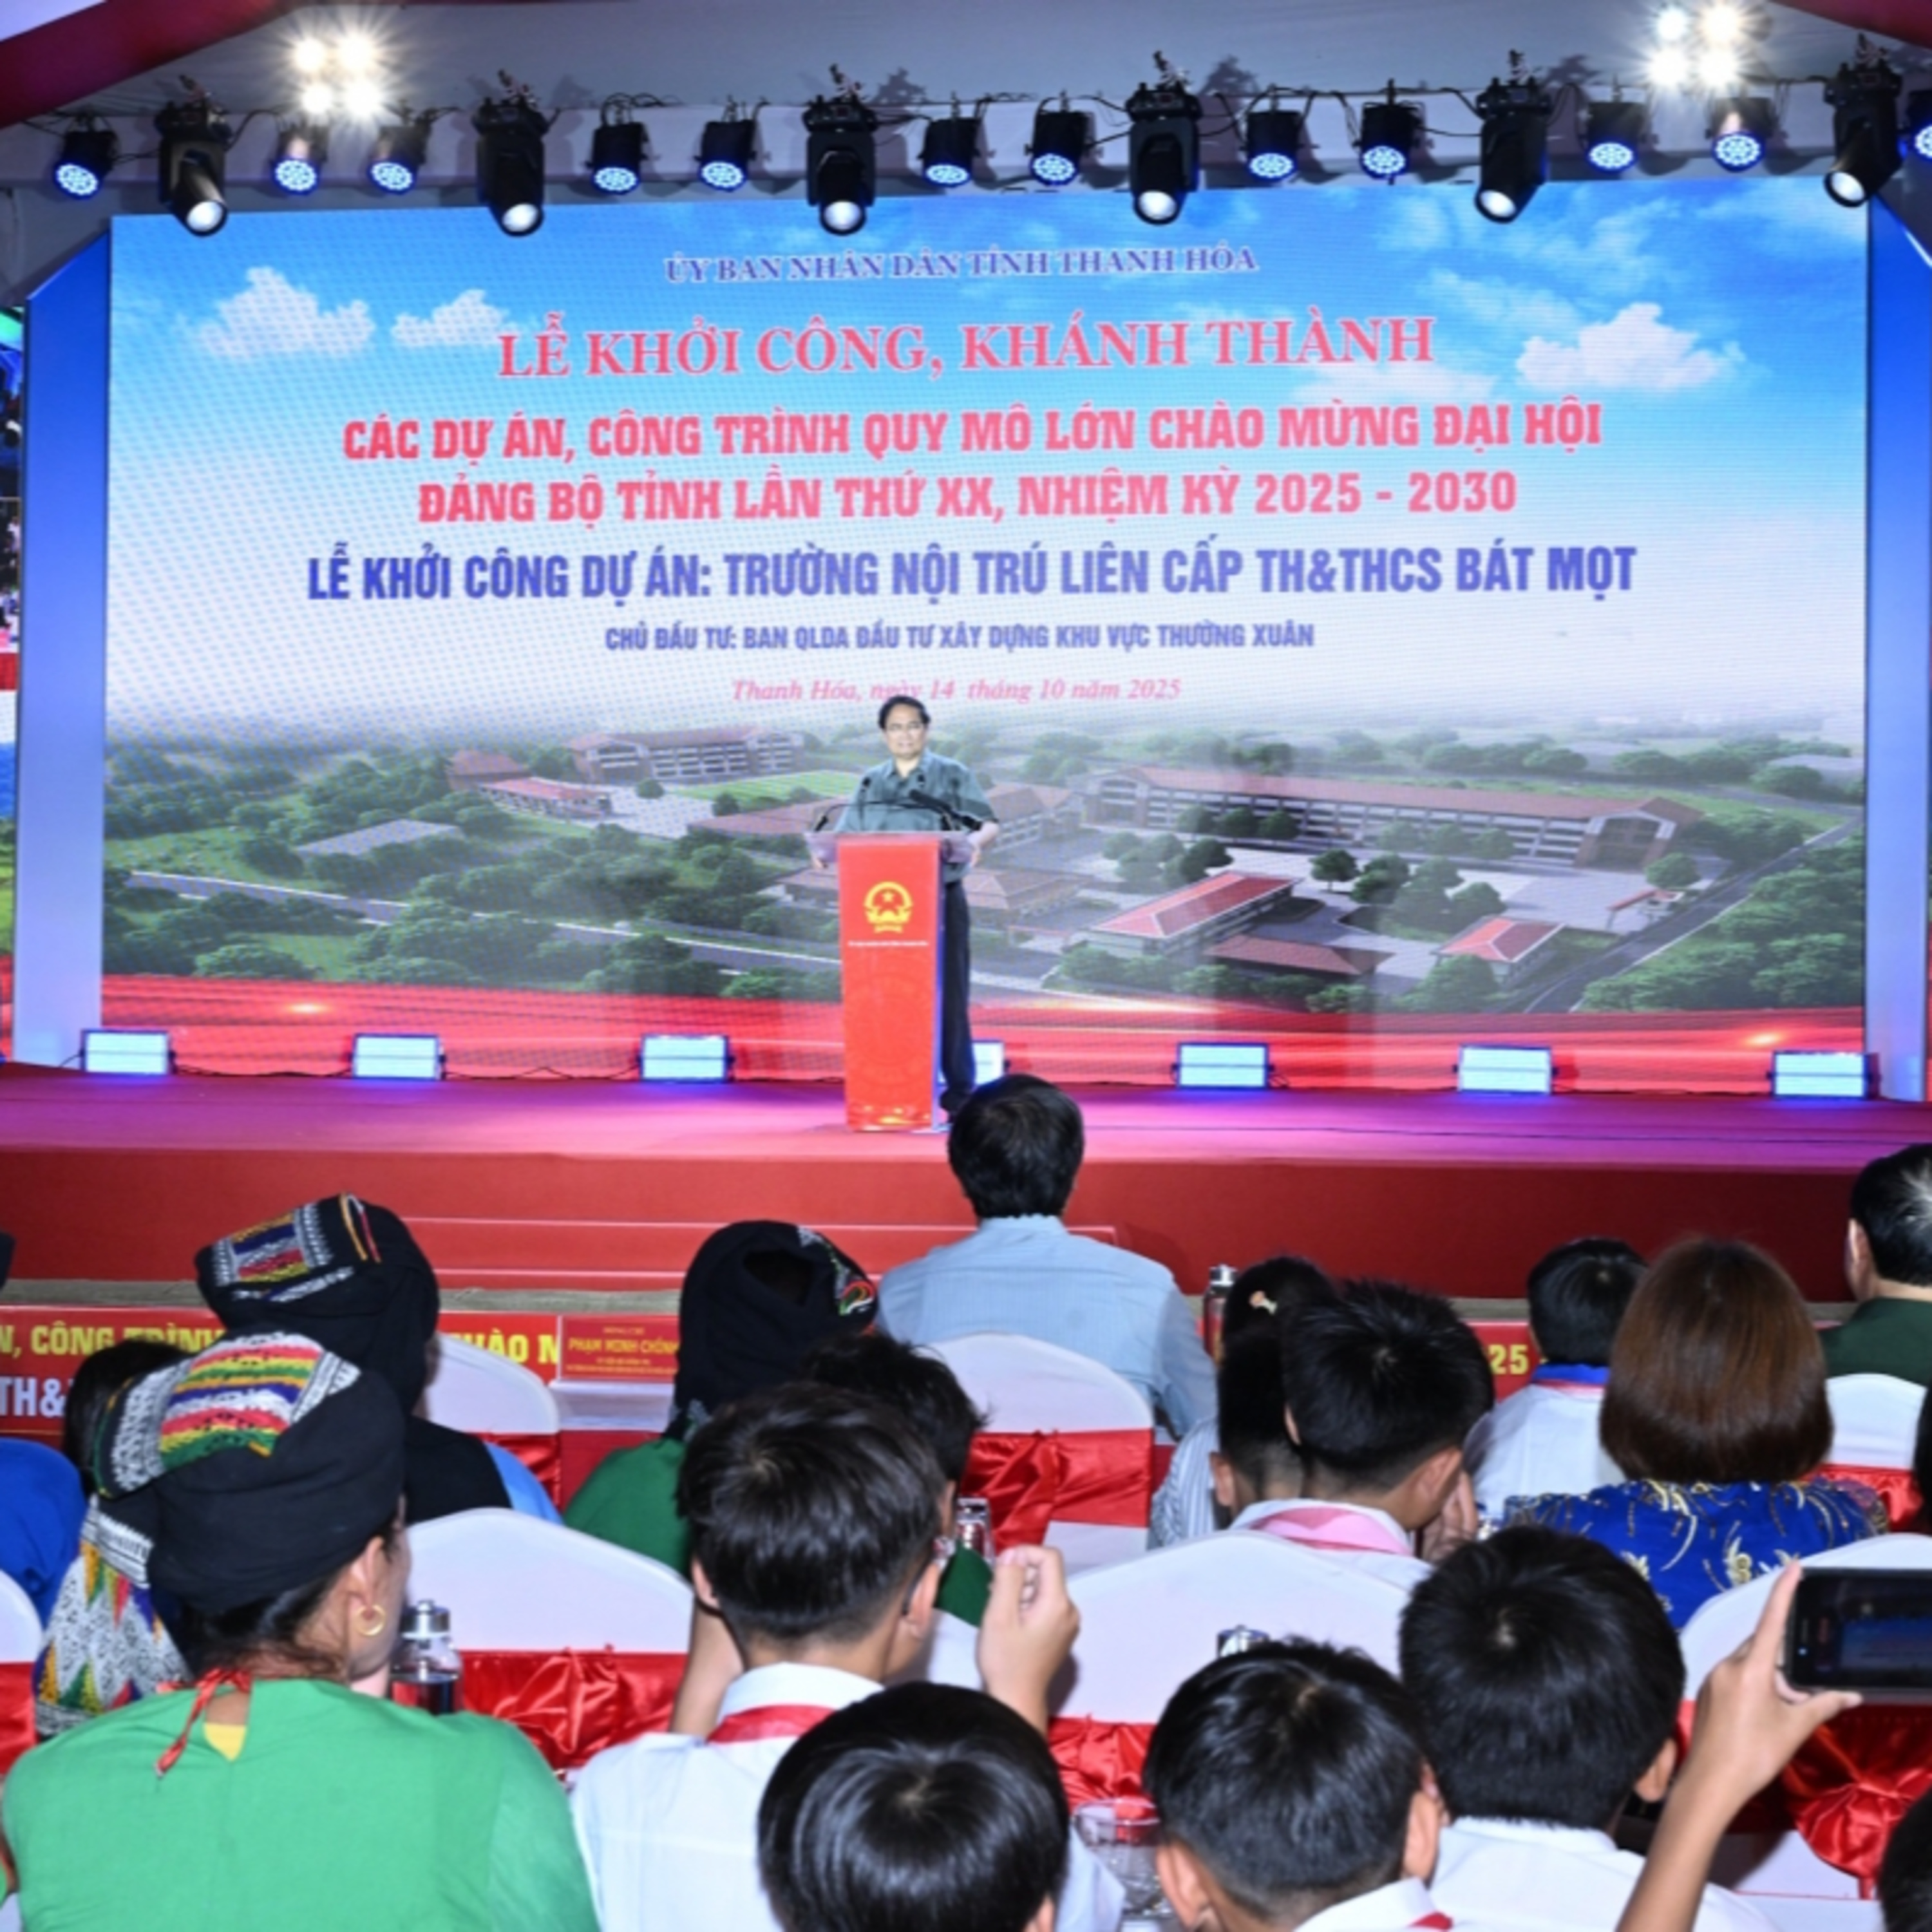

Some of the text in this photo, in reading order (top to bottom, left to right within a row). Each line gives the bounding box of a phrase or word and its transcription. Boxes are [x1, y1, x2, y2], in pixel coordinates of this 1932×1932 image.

[717, 258, 781, 281] BAN
[790, 250, 883, 279] NHÂN
[891, 248, 960, 278] DÂN
[1059, 250, 1175, 274] THANH
[1184, 242, 1258, 272] HÓA
[498, 306, 1434, 380] LỄ KHỞI CÔNG, KHÁNH THÀNH
[343, 394, 1602, 467] CÁC DỰ ÁN, CÔNG TRÌNH QUY MÔ LỚN CHÀO MỪNG ĐẠI HỘI
[418, 463, 1517, 530] ĐẢNG BỘ TỈNH LẦN THỨ XX, NHIỆM KỲ 2025 - 2030
[307, 533, 1638, 607] LỄ KHỞI CÔNG DỰ ÁN: TRƯỜNG NỘI TRÚ LIÊN CẤP TH&THCS BÁT MỌT
[605, 620, 649, 651] CHỦ
[743, 626, 788, 649] BAN
[794, 625, 849, 651] QLDA
[906, 623, 935, 649] TƯ
[940, 620, 983, 649] XÂY
[989, 623, 1049, 653] DỰNG
[1056, 624, 1101, 649] KHU
[1106, 622, 1151, 653] VỰC
[1157, 618, 1245, 648] THƯỜNG
[1252, 619, 1314, 647] XUÂN
[732, 678, 802, 701] Thanh
[931, 679, 955, 700] 14
[968, 677, 1032, 704] tháng
[1040, 677, 1066, 700] 10
[1071, 678, 1121, 700] năm
[1127, 677, 1181, 700] 2025
[31, 1320, 115, 1356] CÔNG
